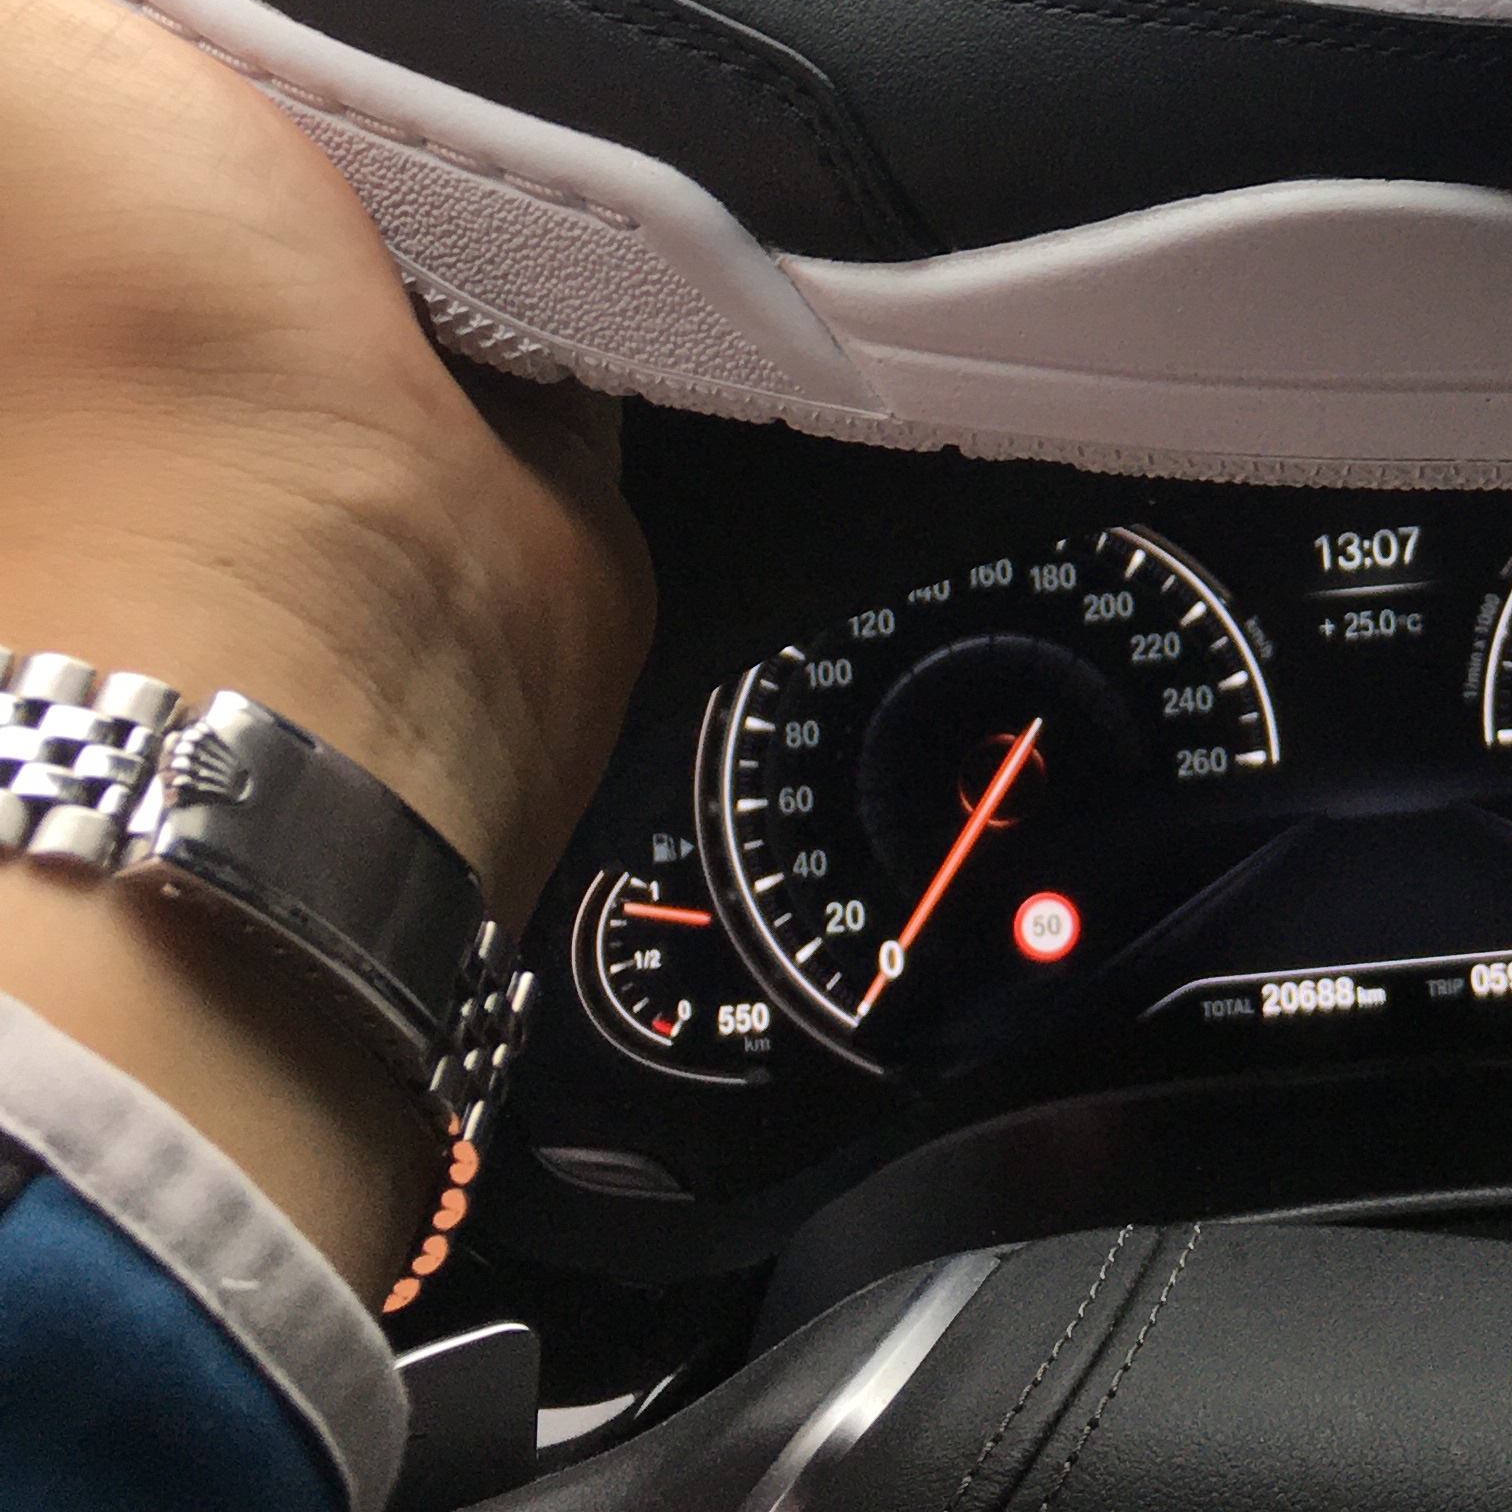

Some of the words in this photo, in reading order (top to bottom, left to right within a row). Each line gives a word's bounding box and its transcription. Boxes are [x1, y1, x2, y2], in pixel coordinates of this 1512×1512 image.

[1314, 526, 1419, 572] 13:07
[971, 558, 1014, 588] 160
[1030, 562, 1077, 592] 180
[1083, 590, 1135, 622] 200
[849, 608, 896, 638] 120
[1130, 632, 1181, 663] 220
[805, 658, 853, 689] 100
[1162, 684, 1214, 715] 240
[785, 719, 820, 749] 80
[1177, 746, 1228, 778] 260
[778, 785, 814, 815] 60
[792, 849, 828, 878] 40
[650, 880, 660, 902] 1
[826, 899, 866, 934] 20
[1032, 912, 1062, 939] 50
[634, 949, 662, 970] 1/2
[878, 939, 906, 980] 0
[1427, 977, 1466, 997] TRIP
[678, 999, 692, 1021] 0
[718, 1002, 770, 1035] 550
[1203, 998, 1255, 1018] TOTAL
[744, 1037, 771, 1053] km
